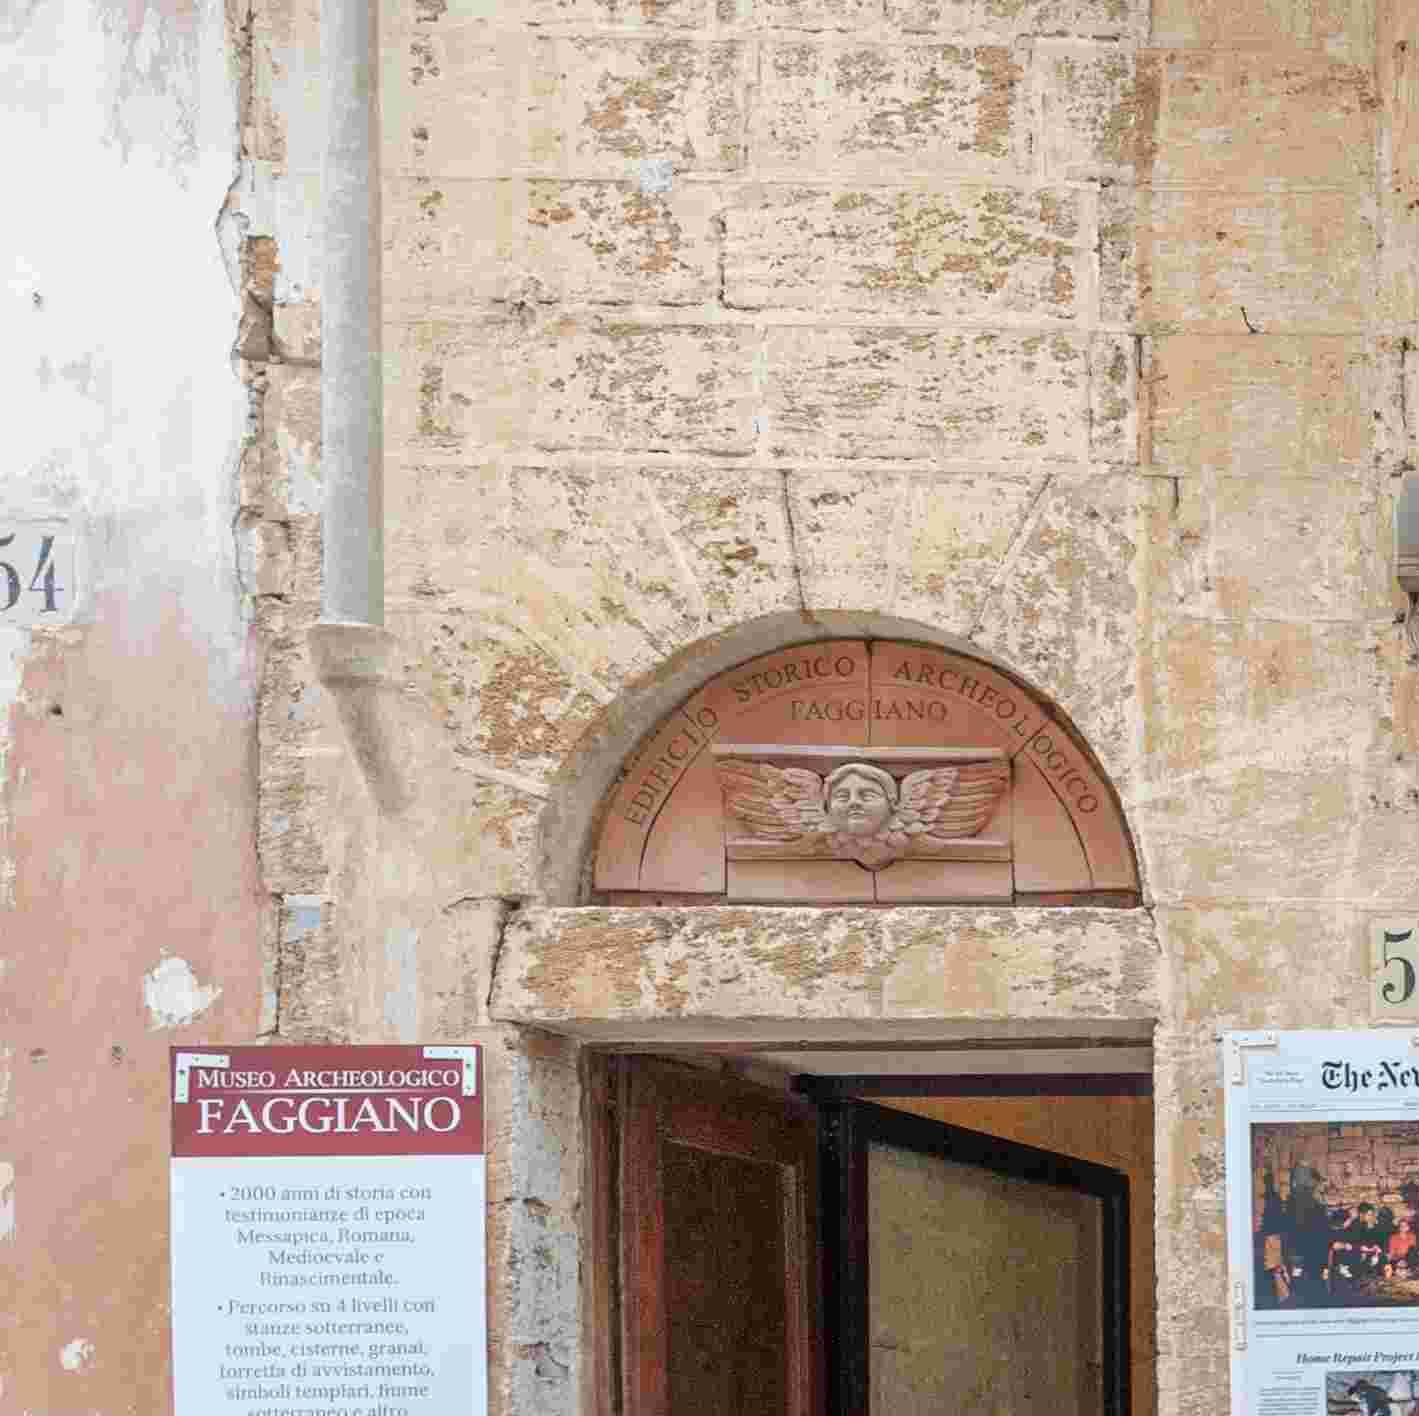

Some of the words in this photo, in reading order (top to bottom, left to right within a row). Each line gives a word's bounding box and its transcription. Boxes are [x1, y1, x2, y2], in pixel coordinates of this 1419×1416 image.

[790, 699, 949, 722] FAGGIANO
[624, 707, 718, 826] EDIFICIO
[733, 655, 856, 706] STORICO
[892, 655, 1099, 817] ARCHEOLOGICO
[199, 1069, 275, 1089] MUSEO
[284, 1068, 459, 1088] ARCHEOLOGICO
[1321, 1058, 1373, 1093] The
[197, 1096, 461, 1134] FAGGIANO
[231, 1185, 276, 1201] 2000
[281, 1186, 319, 1200] anni
[324, 1185, 339, 1200] di
[344, 1185, 394, 1200] storia
[400, 1187, 432, 1200] con
[225, 1207, 349, 1223] testimonianze
[353, 1206, 369, 1221] di
[375, 1208, 425, 1224] epoca
[227, 1299, 306, 1314] Percorso
[352, 1297, 398, 1312] livelli
[404, 1299, 435, 1312] con
[291, 1362, 306, 1377] di
